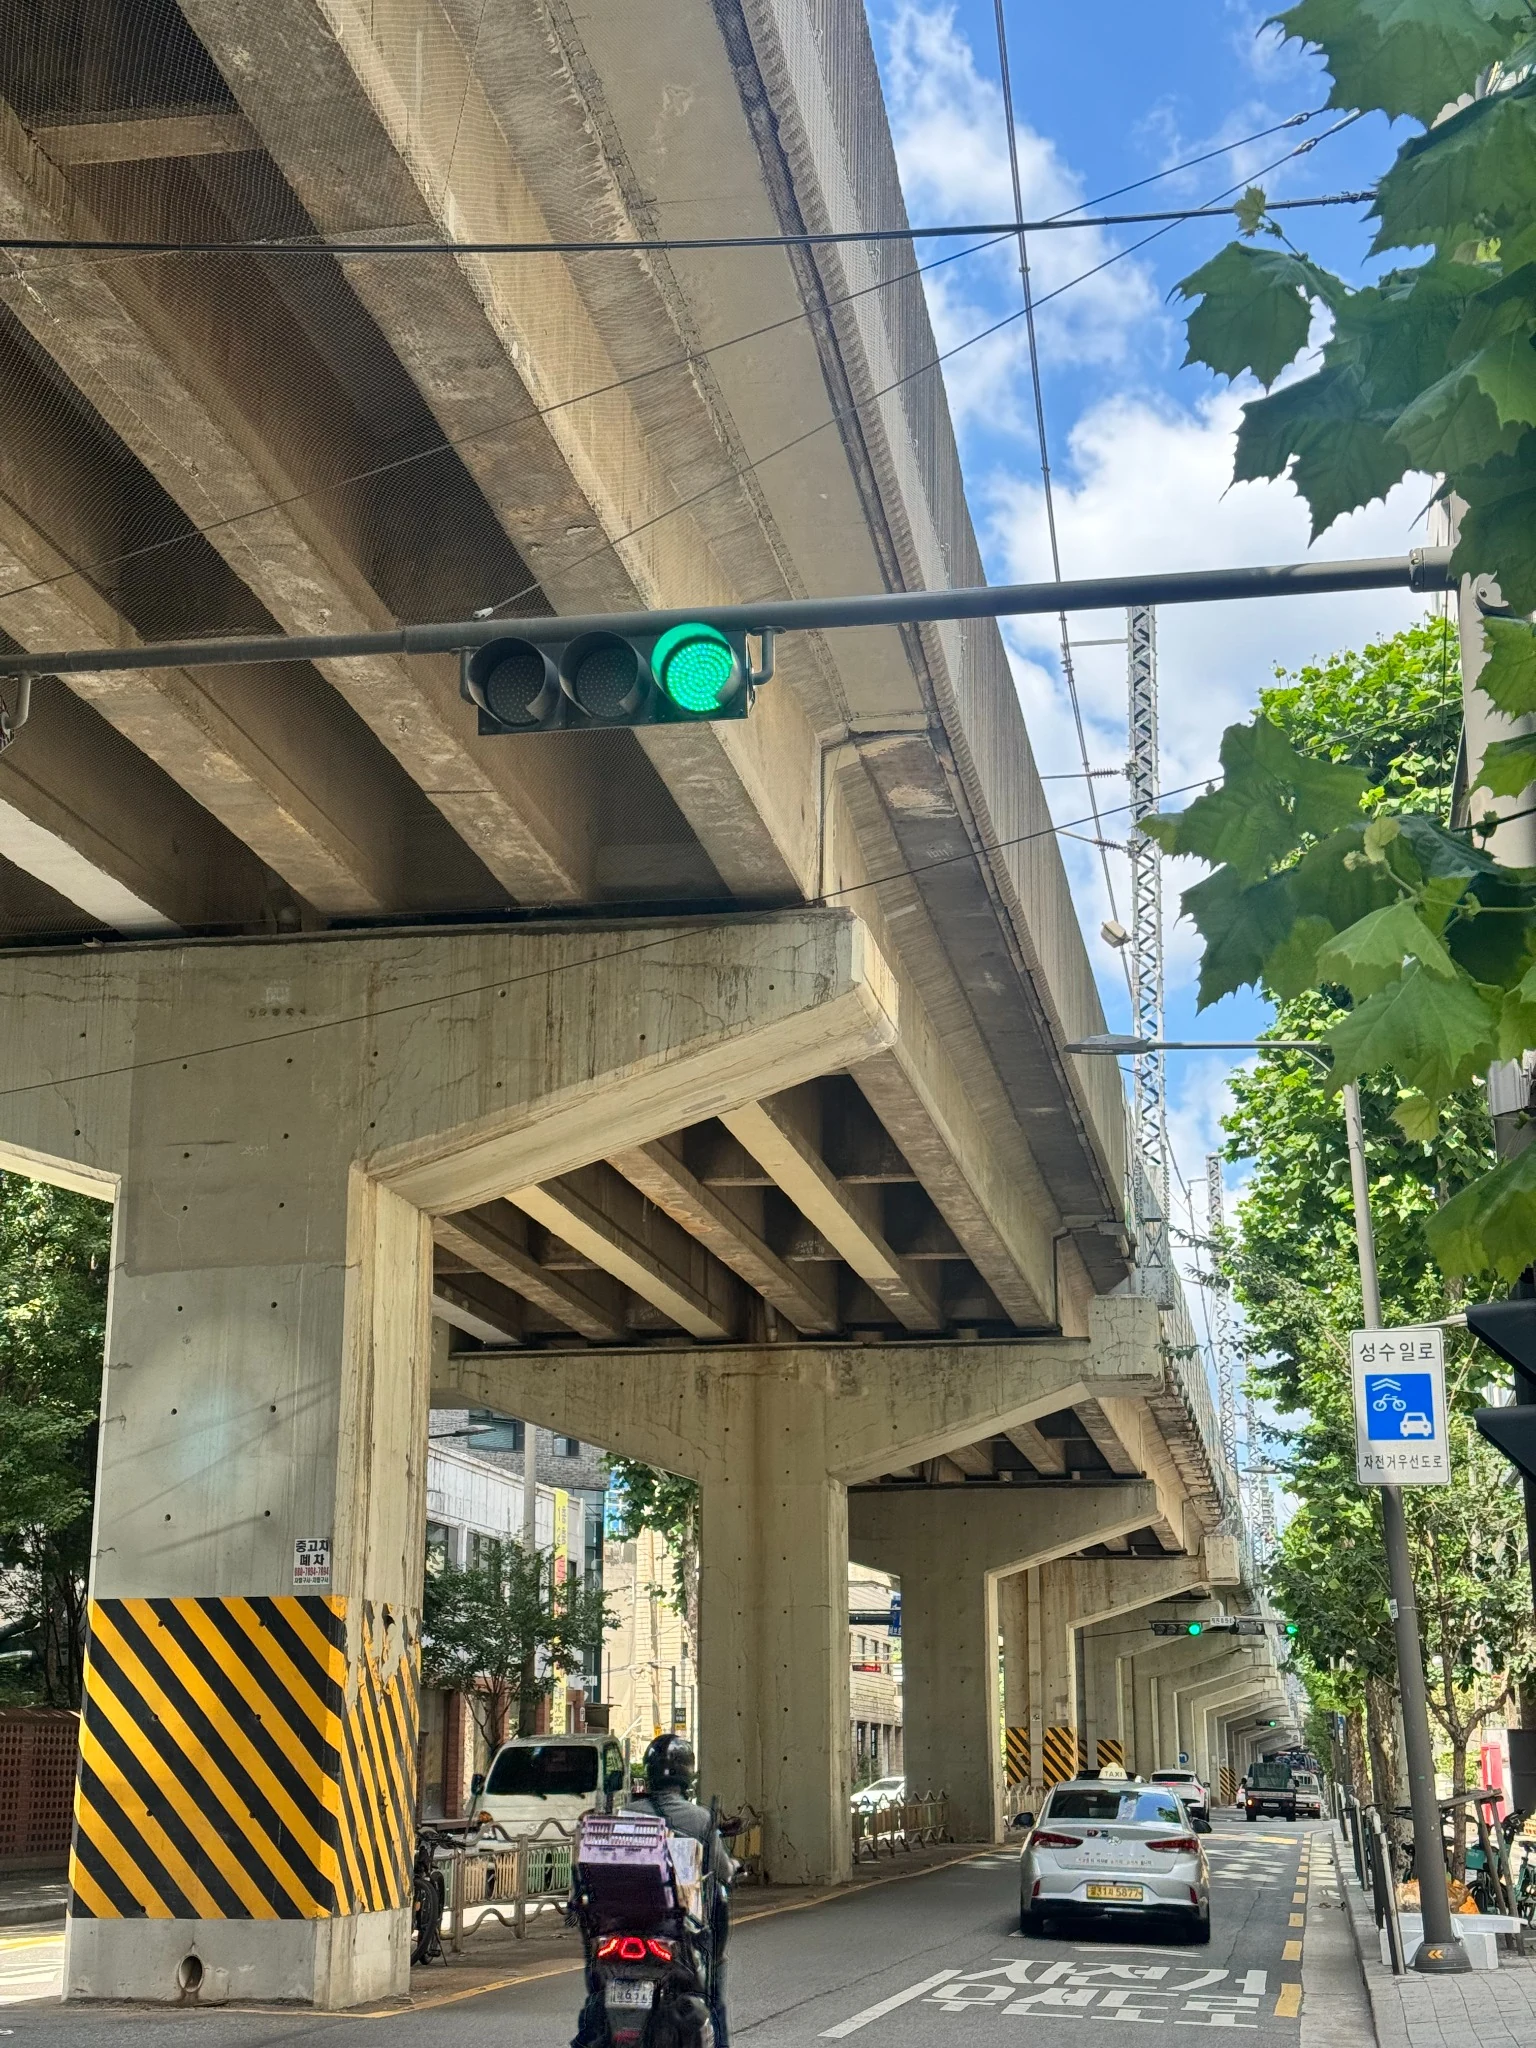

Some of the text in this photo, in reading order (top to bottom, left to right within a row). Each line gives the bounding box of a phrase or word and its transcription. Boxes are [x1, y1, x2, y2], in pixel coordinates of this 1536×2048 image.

[1360, 1341, 1435, 1362] 성수일로
[1364, 1454, 1443, 1469] 자전거우선도로
[953, 1958, 1267, 1995] 자전거
[921, 1983, 1260, 2028] 우선도로
